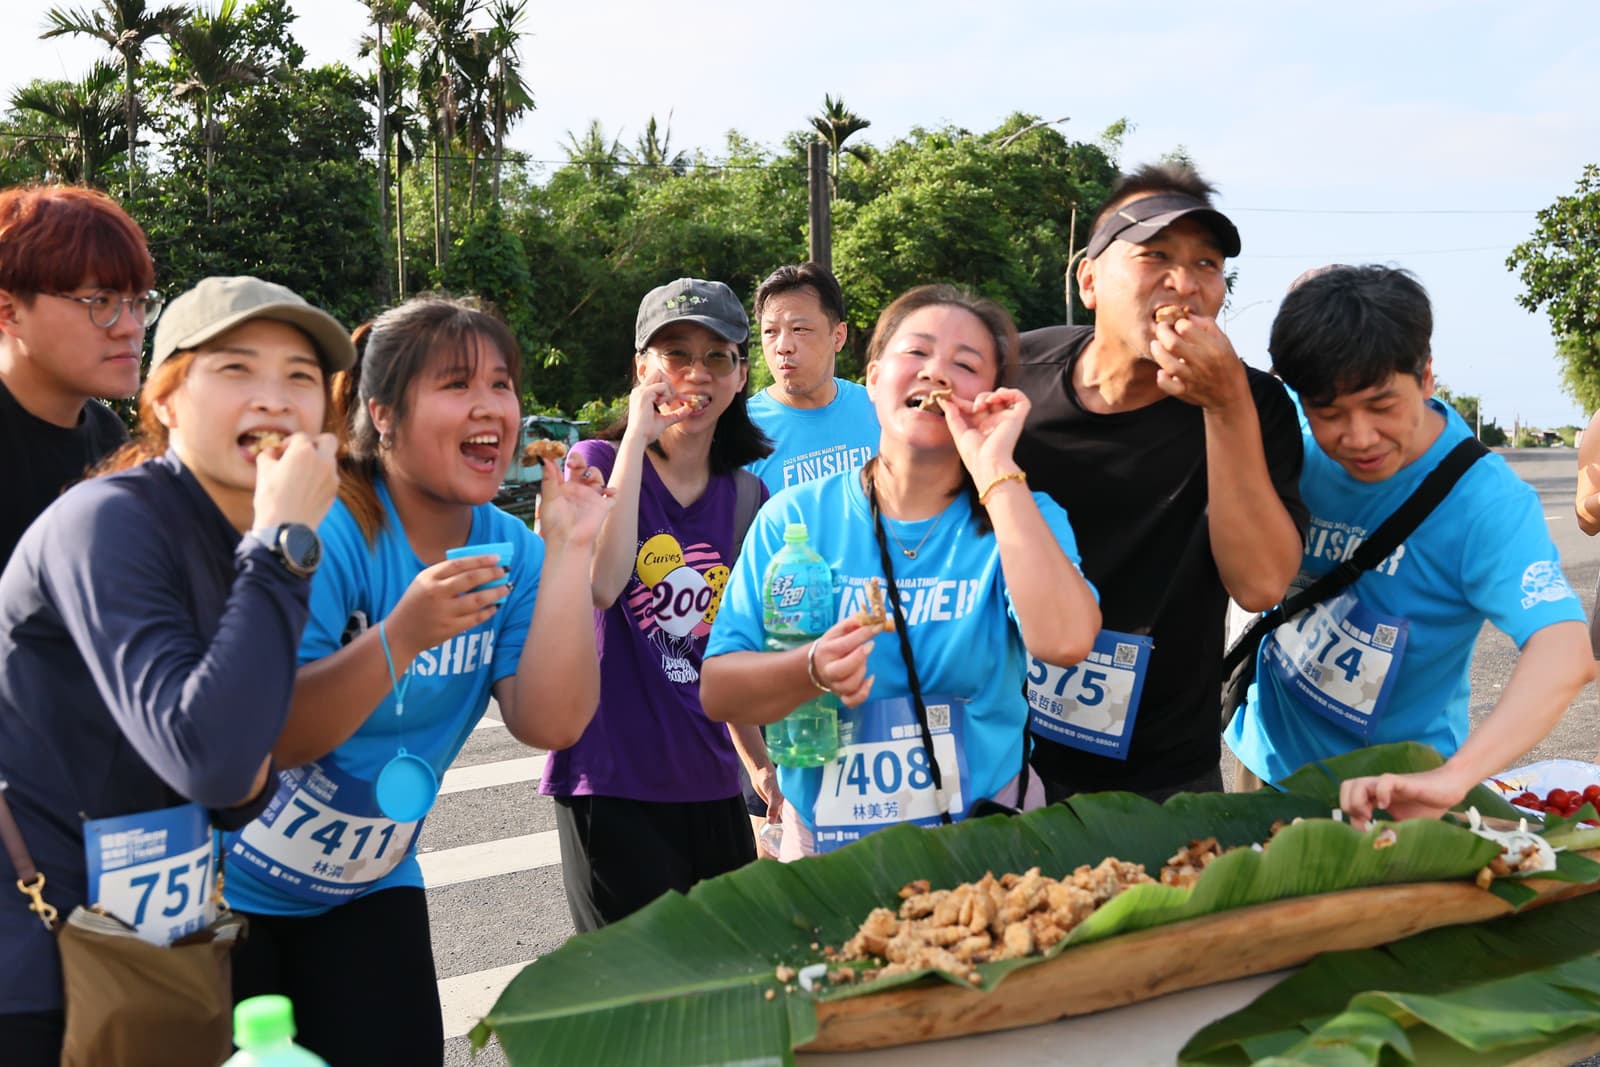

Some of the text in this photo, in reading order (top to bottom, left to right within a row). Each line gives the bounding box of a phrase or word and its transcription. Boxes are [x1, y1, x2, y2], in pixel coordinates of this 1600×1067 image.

[783, 446, 872, 488] FINISHER
[643, 551, 681, 566] Curves
[644, 581, 713, 621] 200
[835, 746, 934, 797] 7408
[283, 797, 397, 860] 7411
[853, 801, 899, 820] 林美芳
